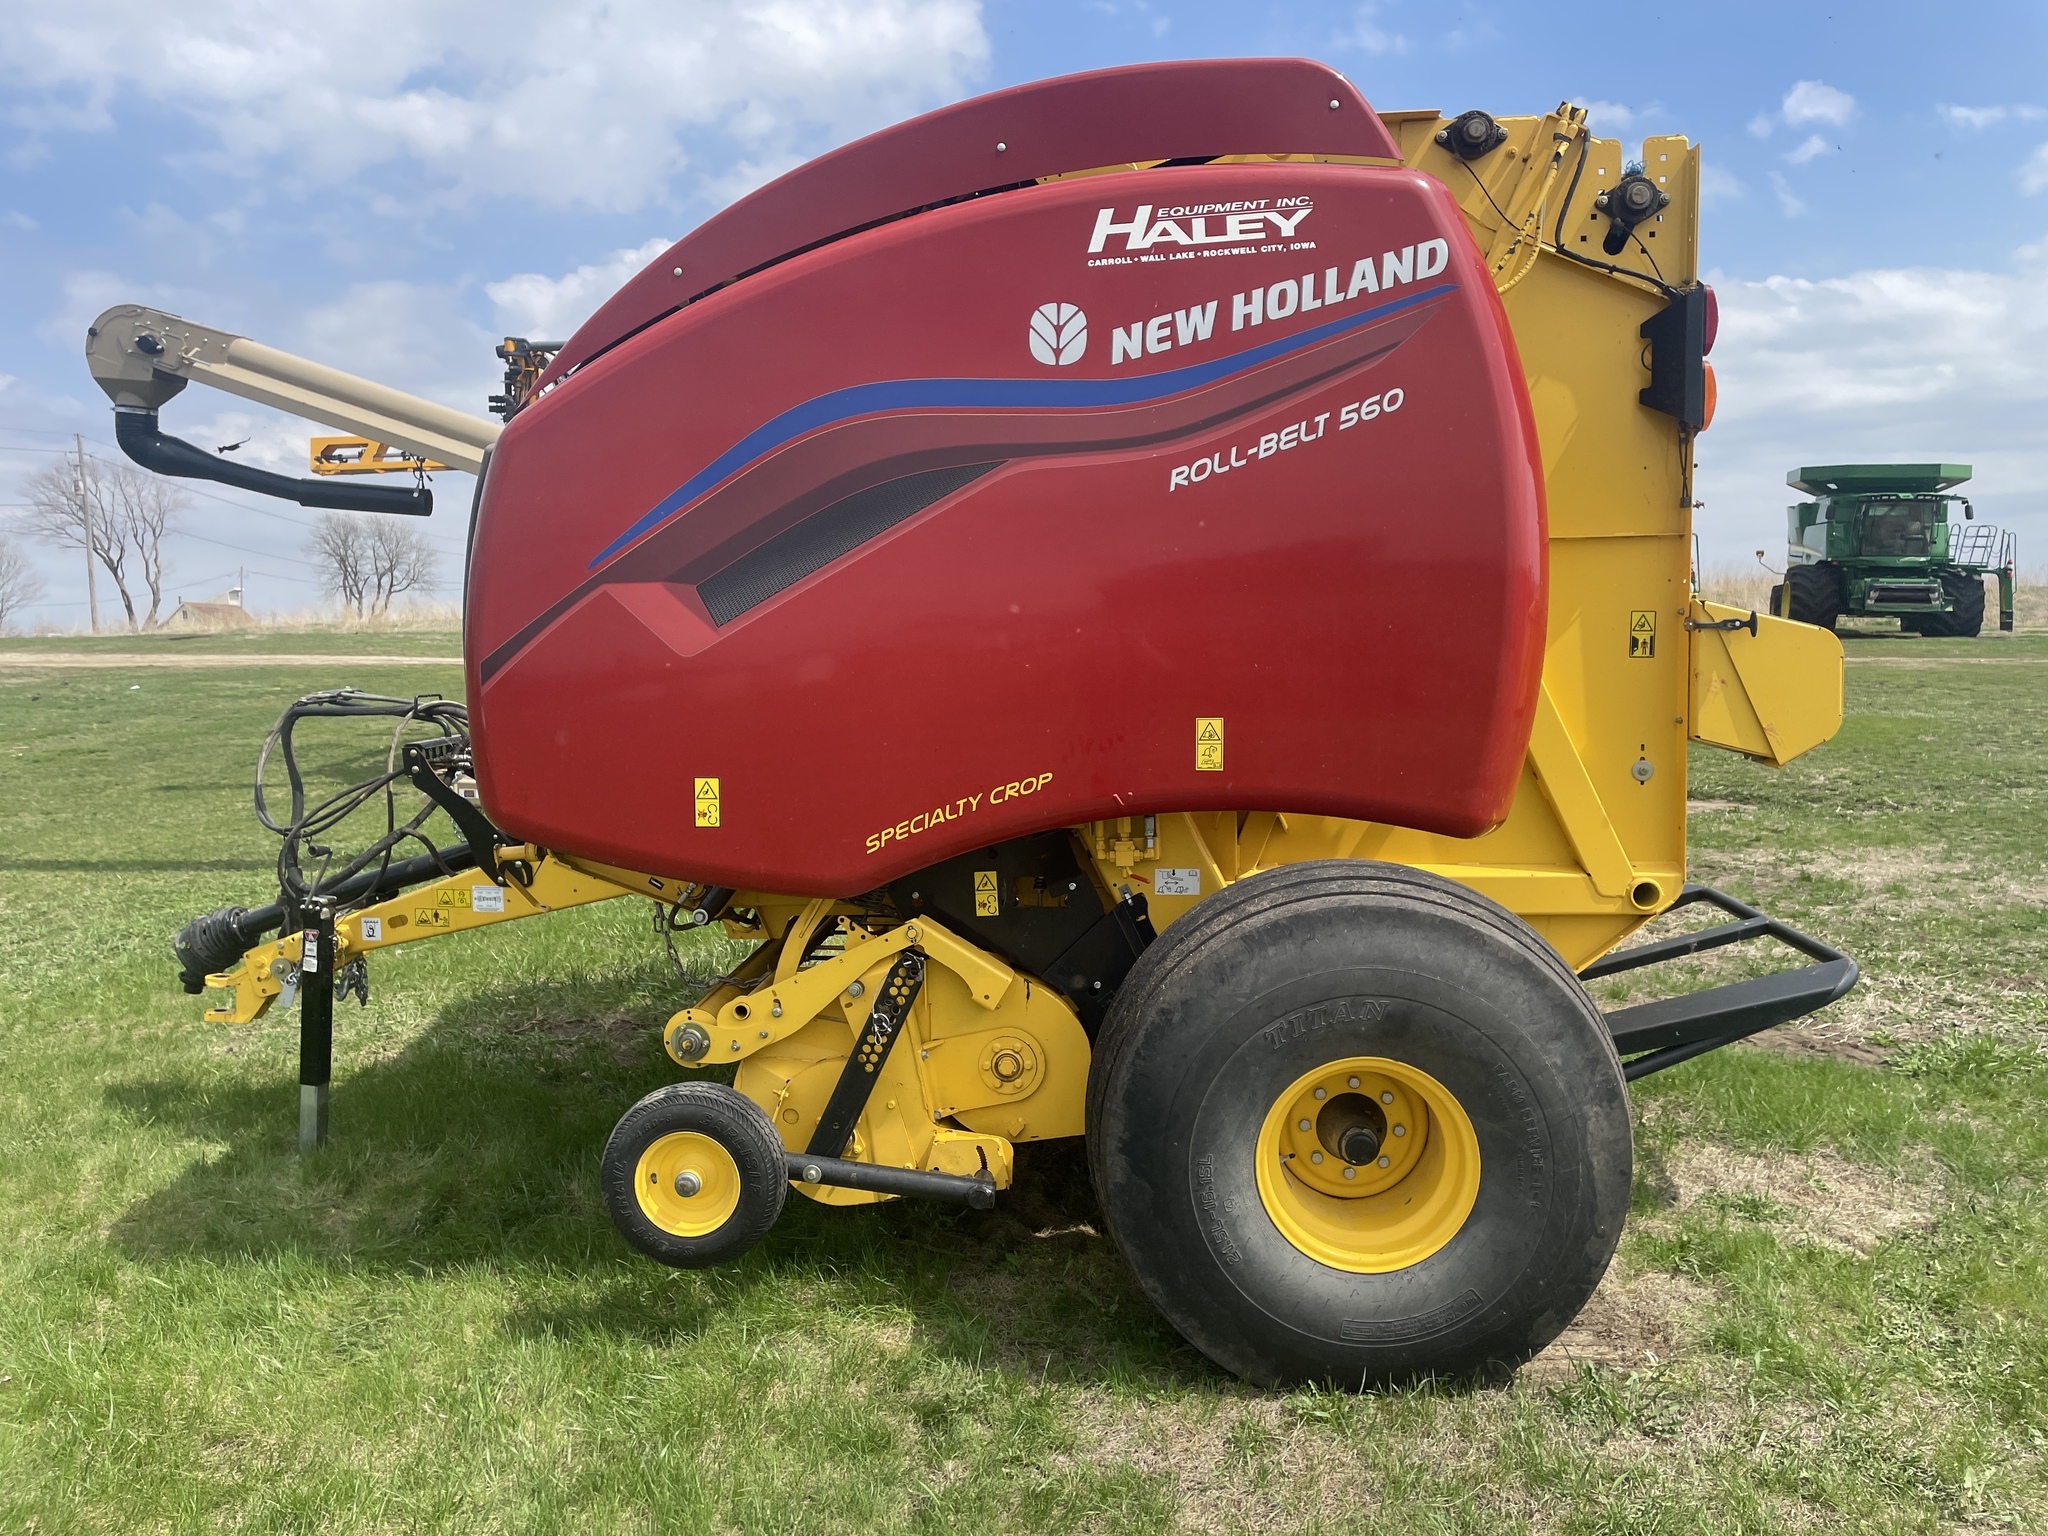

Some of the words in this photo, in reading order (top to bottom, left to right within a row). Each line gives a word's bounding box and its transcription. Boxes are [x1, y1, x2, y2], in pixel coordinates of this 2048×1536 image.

[1087, 204, 1313, 253] HALEY
[1157, 199, 1270, 218] EQUIPMENT
[1276, 195, 1314, 208] INC.
[1088, 256, 1133, 267] CARROLL
[1140, 253, 1166, 263] WALL
[1169, 251, 1195, 261] LAKE
[1203, 246, 1257, 258] ROCKWELL
[1260, 243, 1287, 253] CITY,
[1290, 241, 1317, 251] IOWA
[1111, 299, 1218, 366] NEW
[1232, 236, 1450, 332] HOLLAND
[1169, 412, 1330, 493] ROLL-BELT
[1339, 387, 1405, 431] 560
[865, 792, 983, 855] SPECIALTY
[989, 772, 1054, 805] CROP
[1263, 999, 1393, 1050] TITAN
